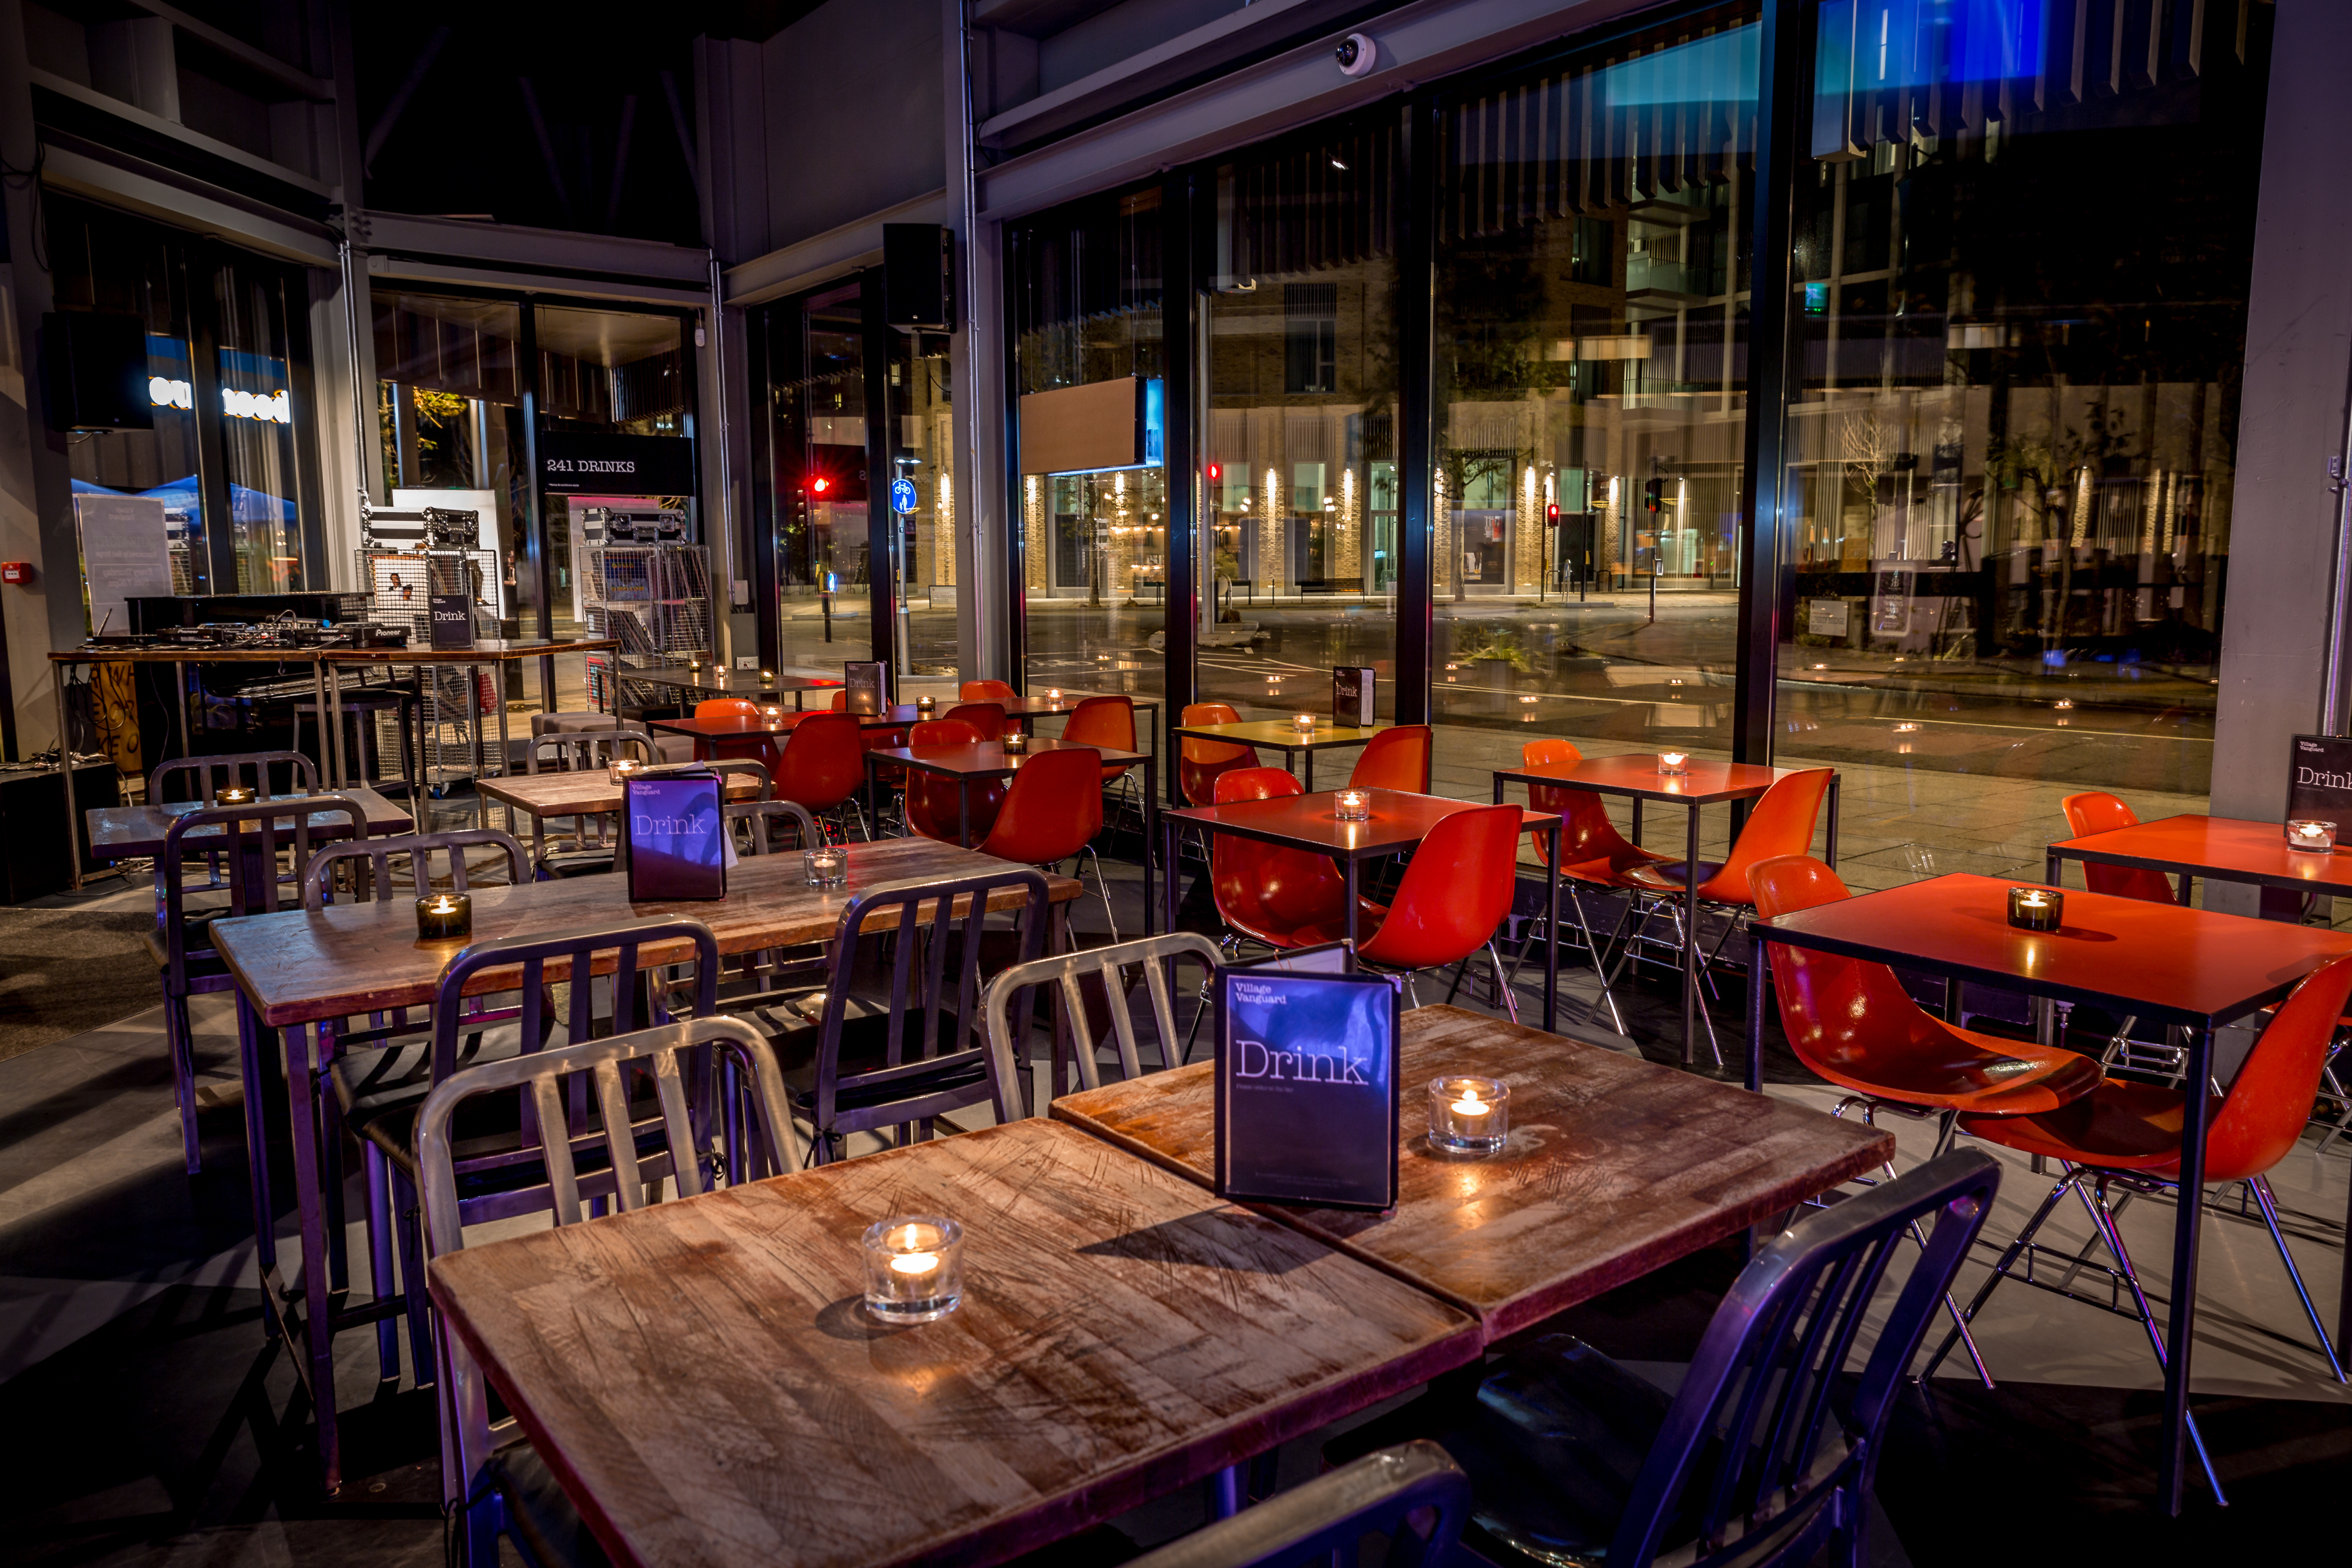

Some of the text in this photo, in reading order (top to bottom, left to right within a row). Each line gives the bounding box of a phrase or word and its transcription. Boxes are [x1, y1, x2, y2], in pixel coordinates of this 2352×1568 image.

[547, 459, 635, 473] 241 DRINKS
[434, 611, 466, 621] Drink
[849, 678, 876, 688] Drink
[1336, 684, 1358, 697] Drink
[634, 814, 707, 836] Drink
[1235, 982, 1272, 995] Village
[1235, 992, 1288, 1005] Vanguard
[1235, 1039, 1369, 1086] Drink
